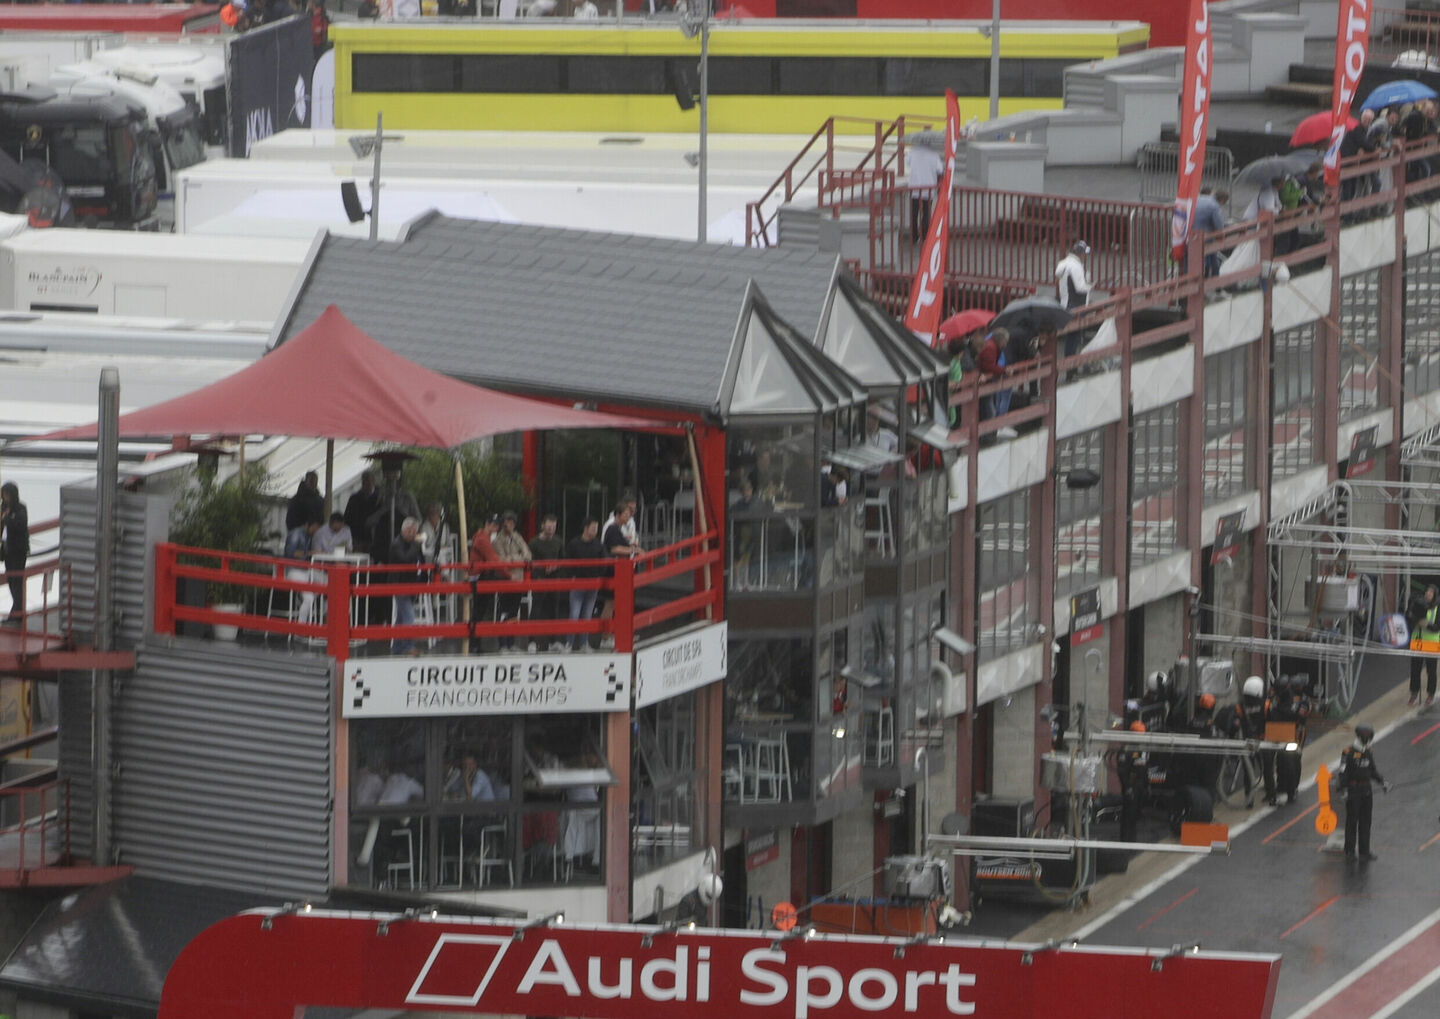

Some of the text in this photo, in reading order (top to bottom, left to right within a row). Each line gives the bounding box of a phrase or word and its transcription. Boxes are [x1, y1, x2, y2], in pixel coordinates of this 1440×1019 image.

[407, 663, 567, 686] CIRCUIT DE SPA
[516, 939, 710, 1003] Audi
